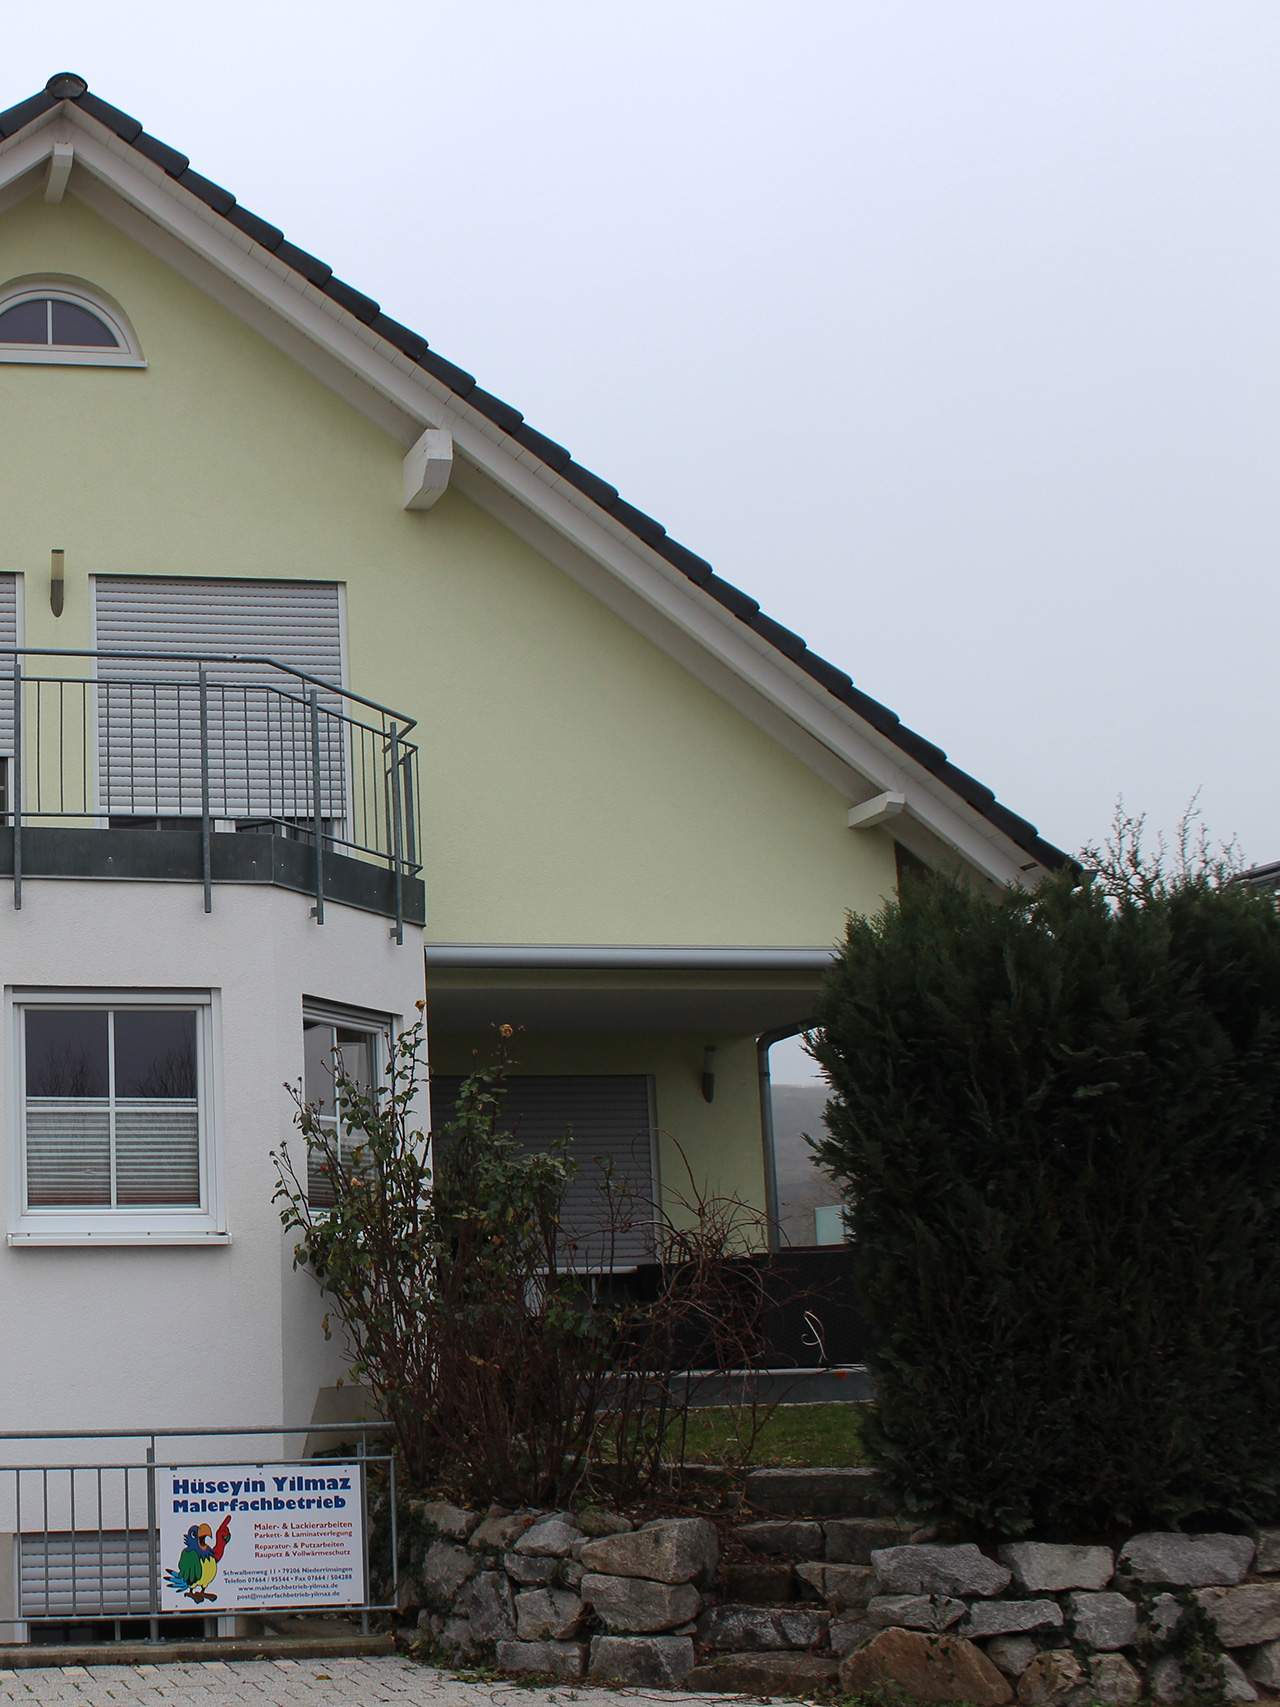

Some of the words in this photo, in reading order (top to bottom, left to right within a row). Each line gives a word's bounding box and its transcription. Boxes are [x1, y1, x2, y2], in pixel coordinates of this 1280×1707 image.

[172, 1477, 266, 1496] Hüseyin
[272, 1476, 352, 1492] Yilmaz
[172, 1495, 347, 1513] Malerfachbetrieb
[282, 1522, 288, 1530] &
[290, 1520, 353, 1530] Lackierarbeiten
[291, 1530, 353, 1538] Laminatverlegung
[254, 1543, 291, 1551] Reparatur-
[300, 1541, 345, 1549] Putzarbeiten
[254, 1551, 283, 1559] Rauputz
[292, 1549, 351, 1557] Vollwärmeschutz
